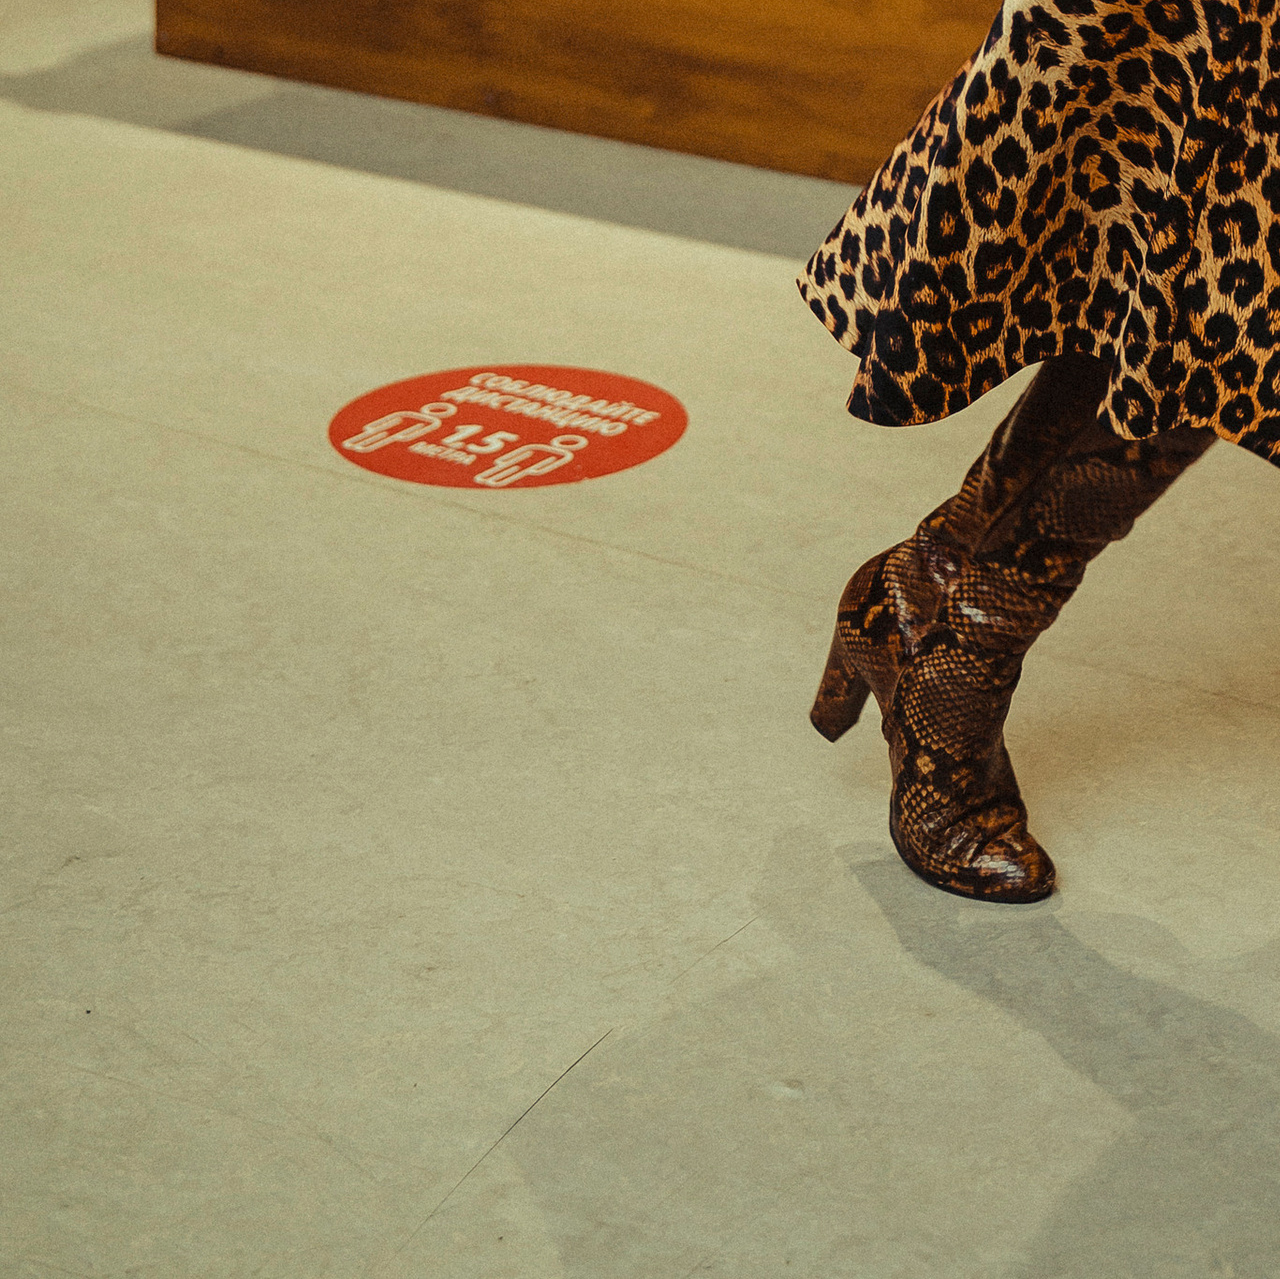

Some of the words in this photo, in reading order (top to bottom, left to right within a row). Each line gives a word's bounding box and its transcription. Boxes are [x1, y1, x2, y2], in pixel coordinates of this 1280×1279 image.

[440, 386, 628, 437] ДИСТАНЦИЮ
[469, 372, 661, 426] СОБЛЮДАЙТЕ
[408, 441, 477, 465] МЕТРА
